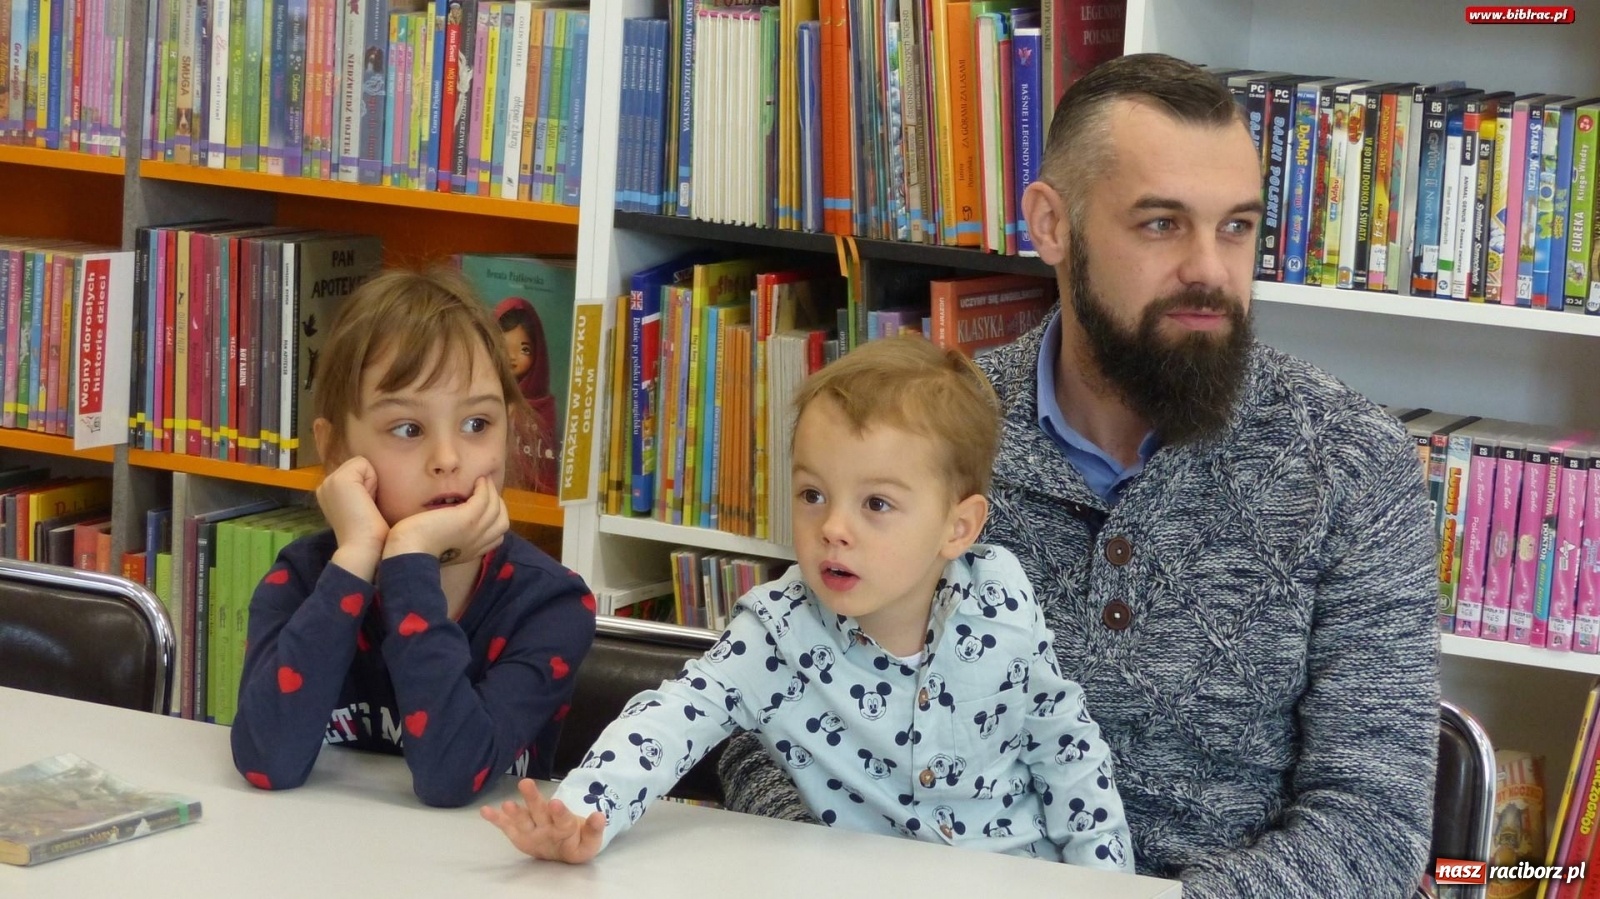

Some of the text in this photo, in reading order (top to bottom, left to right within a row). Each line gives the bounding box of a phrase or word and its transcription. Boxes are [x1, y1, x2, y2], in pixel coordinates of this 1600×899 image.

[1081, 6, 1122, 20] LEGENDY
[684, 28, 692, 66] MOJEGO
[1083, 28, 1120, 46] POLSKIE
[180, 56, 191, 96] SMUGA
[1250, 84, 1264, 93] PC
[343, 54, 356, 155] NIEDŹWIEDŹ WOJTEK
[682, 68, 692, 132] DZIECIŃSTWA
[958, 59, 970, 148] ZA GÓRAMI ZA LASAMI
[1021, 83, 1030, 116] BAŚNIE
[1275, 89, 1289, 98] PC
[509, 131, 520, 149] burzy
[1381, 106, 1390, 144] PODWODNY
[1022, 124, 1030, 168] LEGENDY
[1365, 146, 1373, 157] 80
[1464, 152, 1471, 160] OF
[1480, 144, 1490, 152] PC
[1578, 144, 1588, 170] Wiedzy
[1266, 116, 1285, 228] BAJKI POLSKIE
[1363, 158, 1372, 173] DNI
[1360, 174, 1371, 211] DOOKOŁA
[1576, 171, 1586, 201] Księga
[1358, 212, 1370, 242] ŚWIATA
[1475, 202, 1485, 240] Symulator
[1571, 212, 1584, 253] EUREKA
[332, 250, 354, 268] PAN
[1472, 242, 1483, 285] Samochodu
[312, 276, 362, 299] APOTEK
[486, 268, 544, 285] Renata Piątkowska
[97, 275, 106, 322] dzieci
[960, 294, 987, 308] UCZYMY
[988, 293, 1000, 304] SIĘ
[80, 272, 96, 407] Wojny dorosłych
[634, 316, 642, 342] Baśnie
[957, 312, 1006, 344] KLASYKA
[93, 328, 104, 392] historie
[632, 344, 639, 353] po
[632, 356, 640, 380] polsku
[564, 315, 586, 488] KSIĄŻKI W JĘZYKU
[582, 368, 595, 434] OBCYM
[632, 388, 638, 398] po
[1544, 465, 1557, 515] DIAMENTOWA
[1440, 466, 1462, 584] LUBIĘ SZKOŁĘ
[1539, 522, 1550, 560] DOKTOR
